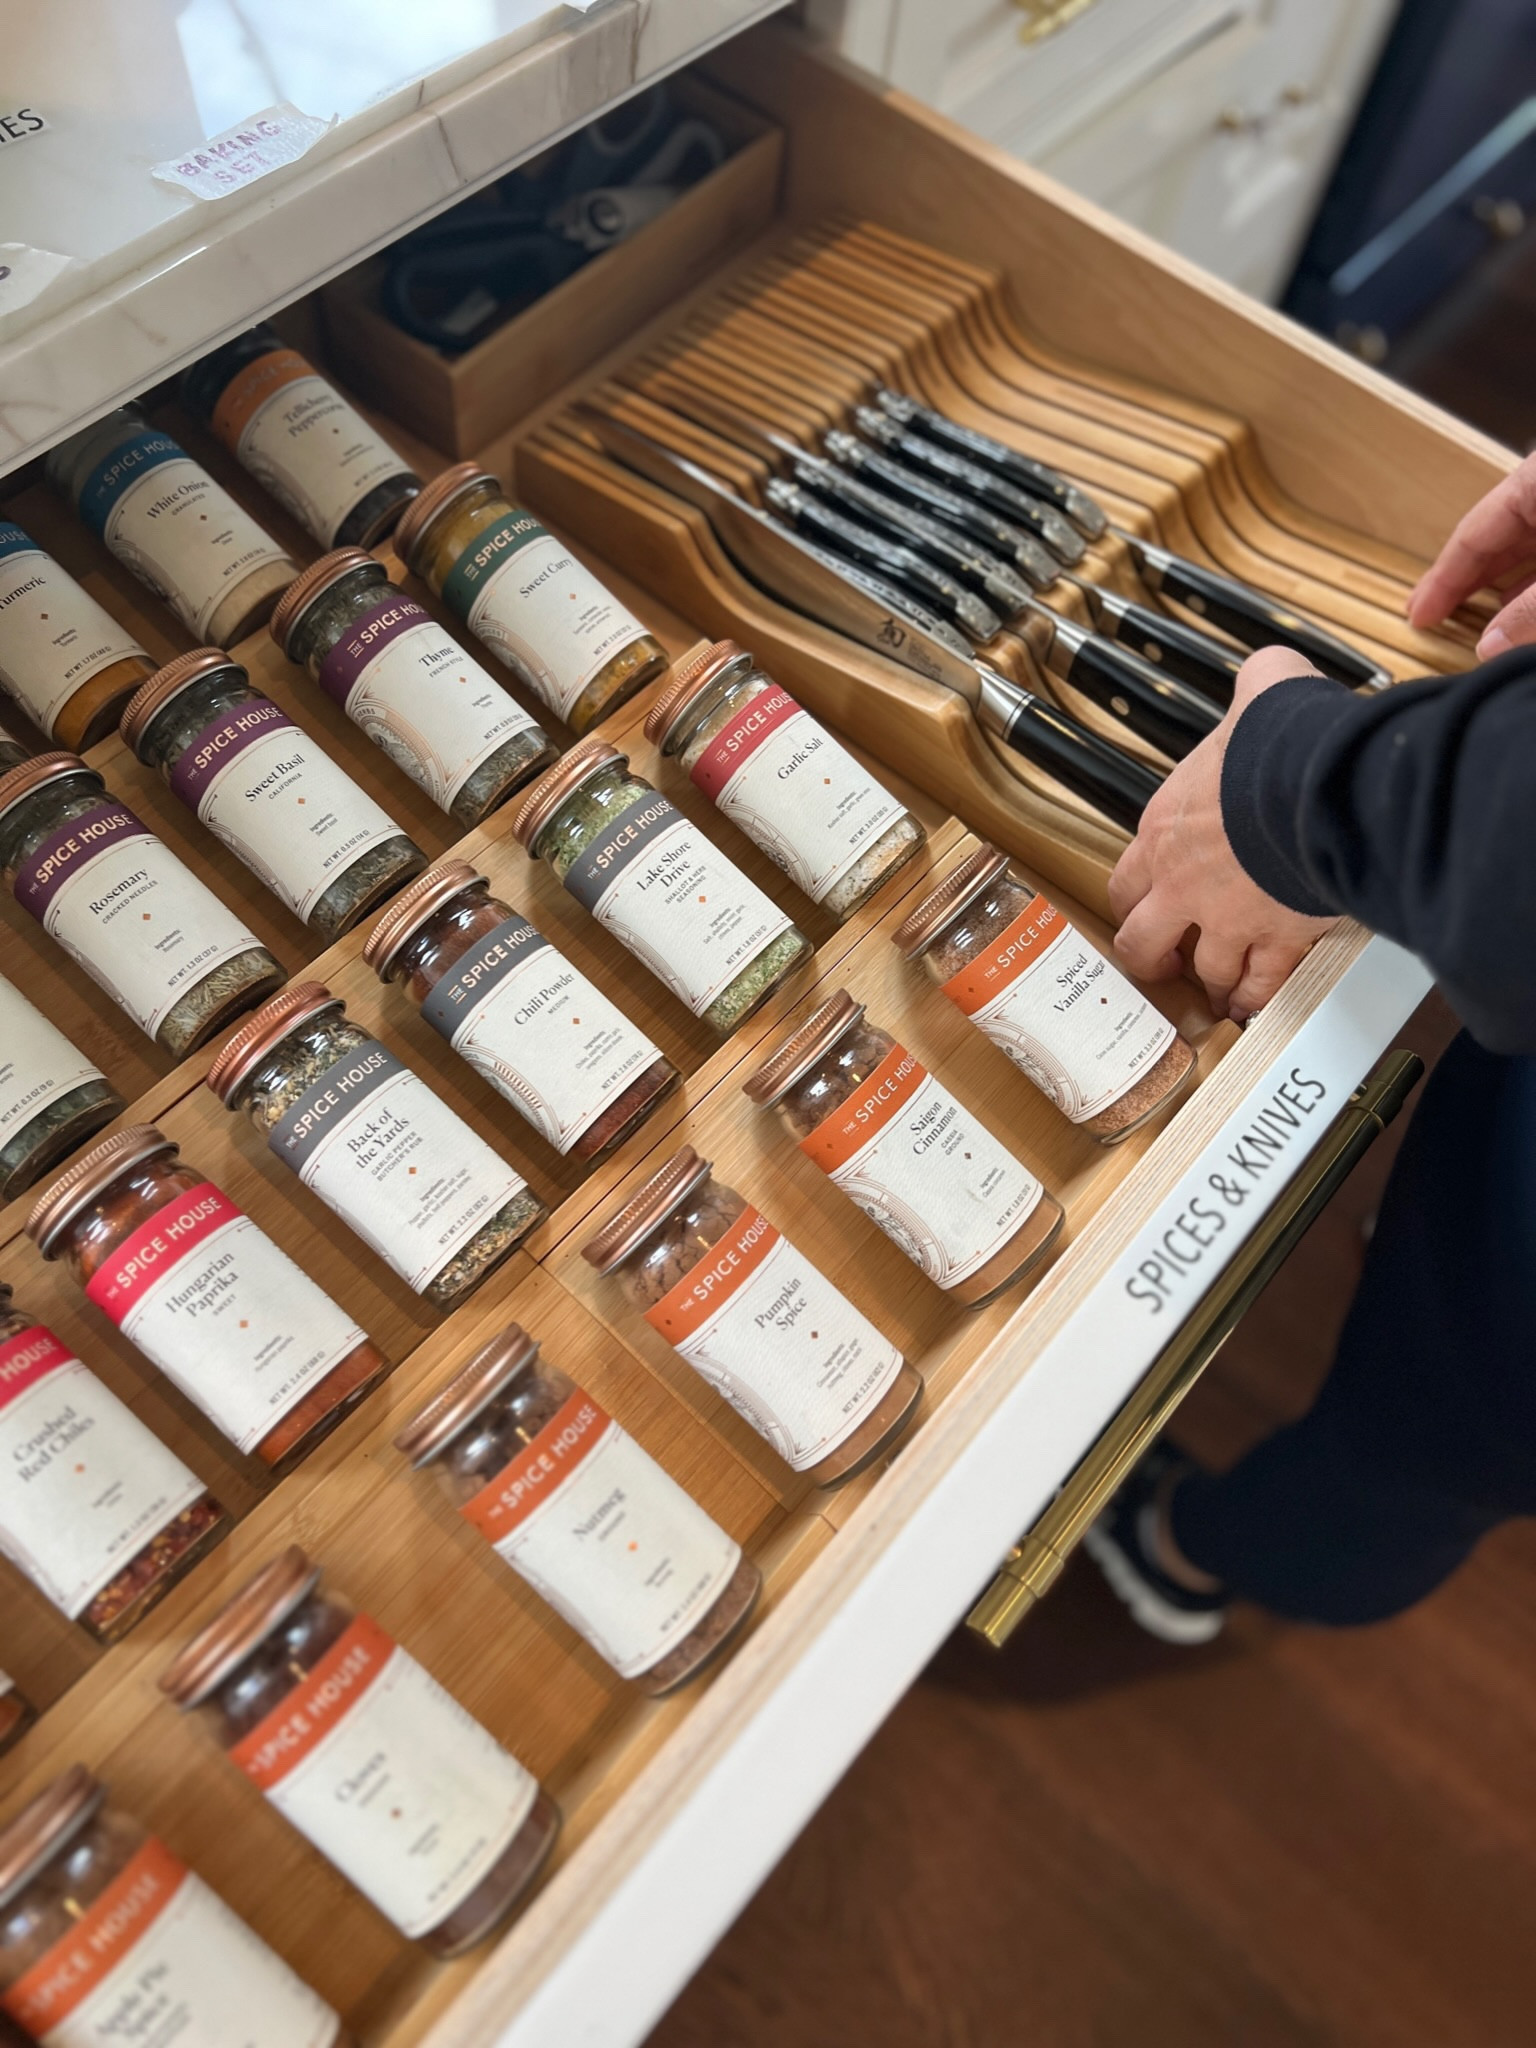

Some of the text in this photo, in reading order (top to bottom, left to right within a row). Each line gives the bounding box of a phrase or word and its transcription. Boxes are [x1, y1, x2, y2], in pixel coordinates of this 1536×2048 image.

[0, 108, 44, 143] ES
[176, 121, 281, 176] BAKING
[214, 150, 270, 182] SET
[104, 450, 144, 485] SPICE
[147, 480, 210, 520] White Onion
[474, 528, 514, 568] SPICE
[512, 518, 542, 535] HOU
[520, 558, 573, 598] Sweet Curry
[360, 609, 402, 644] SPICE
[419, 647, 454, 667] Thyme
[195, 727, 238, 769] SPICE
[236, 707, 283, 731] HOUSE
[717, 692, 794, 763] THE SPICE HOUS
[245, 753, 306, 802] Sweet Basil
[777, 738, 824, 780] Garlic Salt
[269, 772, 303, 800] CALIFORNIA
[36, 838, 81, 883] SPICE
[78, 814, 133, 844] HOUSE
[322, 857, 333, 868] NET
[340, 842, 350, 852] 0.5
[588, 801, 674, 879] THE SPICE HOUSE
[848, 833, 859, 844] NET
[636, 841, 692, 891] Lake Shore
[660, 860, 691, 888] Drive
[89, 868, 149, 915] Rosemary
[102, 898, 130, 924] CRACKED
[664, 880, 689, 905] SHALLOT
[167, 975, 179, 986] NET
[194, 955, 203, 963] OZ
[452, 988, 465, 1000] THE
[462, 944, 508, 988] SPICE
[725, 954, 736, 965] NET
[984, 966, 997, 979] THE
[997, 926, 1039, 968] SPICE
[1056, 953, 1088, 988] Spiced
[514, 973, 575, 1025] Chili Powder
[1053, 960, 1106, 1013] Vanilla Sugar
[30, 1088, 40, 1097] OZ
[293, 1090, 339, 1138] SPICE
[336, 1052, 388, 1094] HOUSE
[843, 1054, 917, 1135] THE SPICE HOUS
[346, 1106, 394, 1154] Back of
[910, 1101, 942, 1136] Saigon
[913, 1106, 958, 1156] Cinnamon
[941, 1129, 958, 1148] CASSIA
[356, 1117, 410, 1169] the Yards
[371, 1131, 417, 1176] GARLIC PEPPER
[1125, 1068, 1326, 1314] SPICES & KNIVES
[116, 1238, 167, 1289] SPICE
[165, 1197, 222, 1240] HOUSE
[438, 1233, 450, 1245] NET
[165, 1252, 235, 1313] Hungarian
[185, 1270, 239, 1317] Paprika
[680, 1298, 694, 1312] THE
[693, 1250, 740, 1301] SPICE
[754, 1278, 801, 1329] Pumpkin
[776, 1296, 808, 1331] Spice
[1, 1338, 57, 1382] HOUSE
[13, 1405, 77, 1462] Crushed
[501, 1404, 598, 1509] SPICE HOUSE
